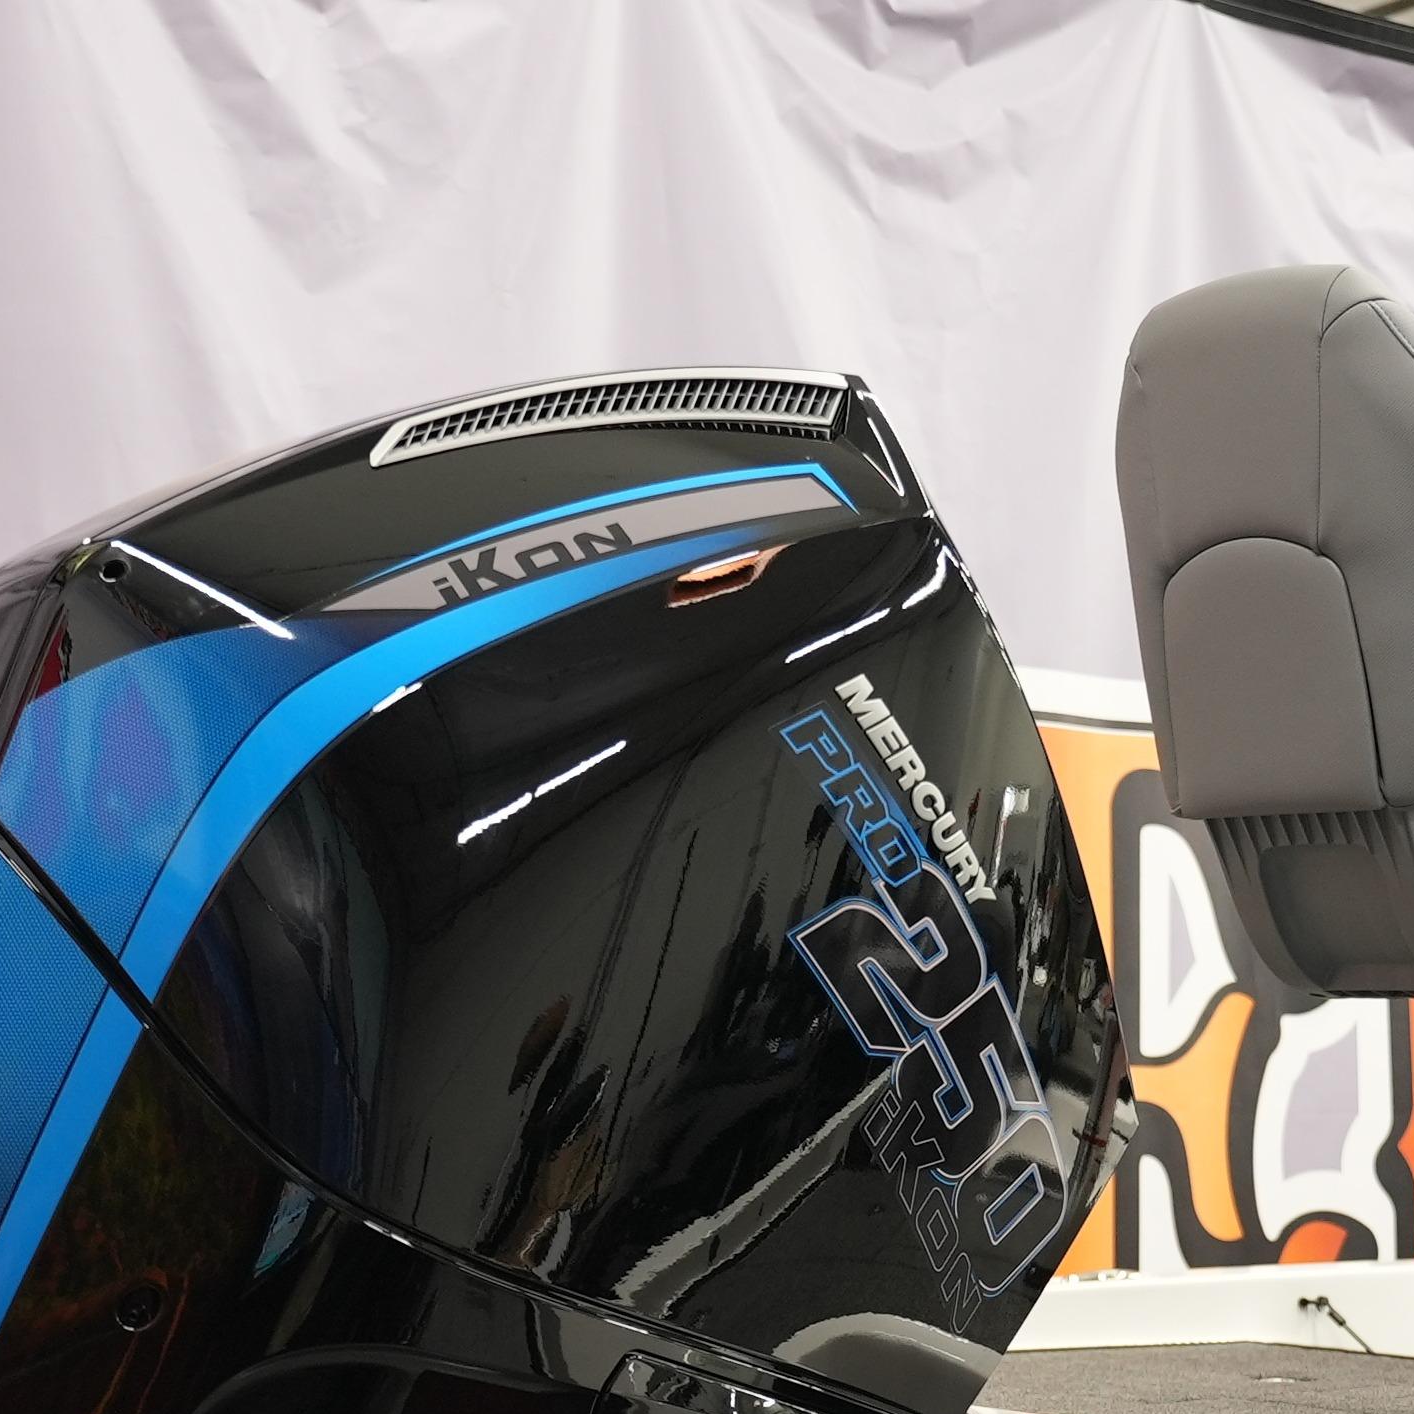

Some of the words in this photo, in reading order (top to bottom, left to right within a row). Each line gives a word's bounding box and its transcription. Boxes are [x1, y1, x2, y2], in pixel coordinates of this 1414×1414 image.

[779, 711, 923, 886] PRO
[833, 673, 997, 906] MERCURY
[787, 860, 1069, 1299] 250
